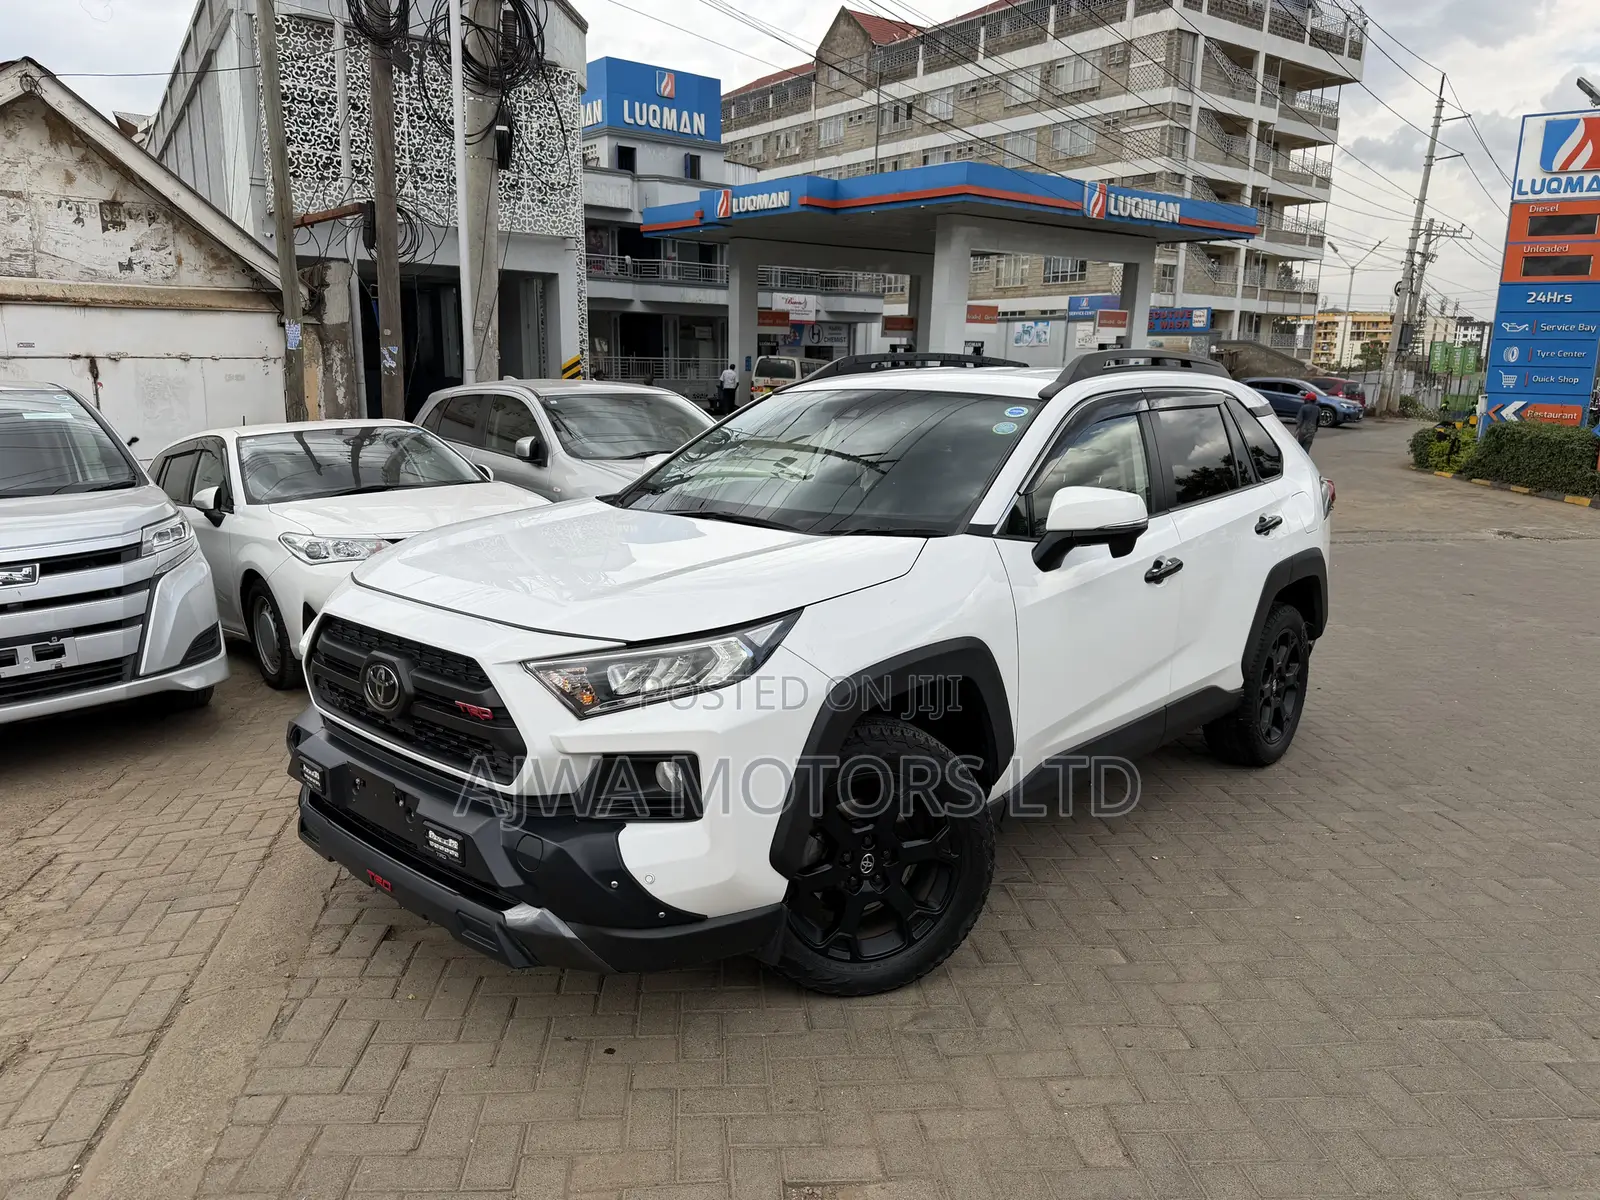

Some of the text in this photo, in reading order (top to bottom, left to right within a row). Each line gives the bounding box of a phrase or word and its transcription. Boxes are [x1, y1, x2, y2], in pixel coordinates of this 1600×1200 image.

[623, 99, 706, 136] LUQMAN
[1516, 174, 1600, 196] LUQMA
[732, 190, 790, 213] LUQMAN
[1108, 193, 1180, 223] LUQMAN
[1529, 204, 1559, 213] Diesel
[1523, 244, 1569, 253] Unleaded
[1526, 291, 1573, 304] 24Hrs
[1541, 323, 1597, 333] Service Bay
[1537, 350, 1587, 358] Tyre Center
[1532, 375, 1579, 385] Quick Shop
[1527, 410, 1577, 420] Restaurant
